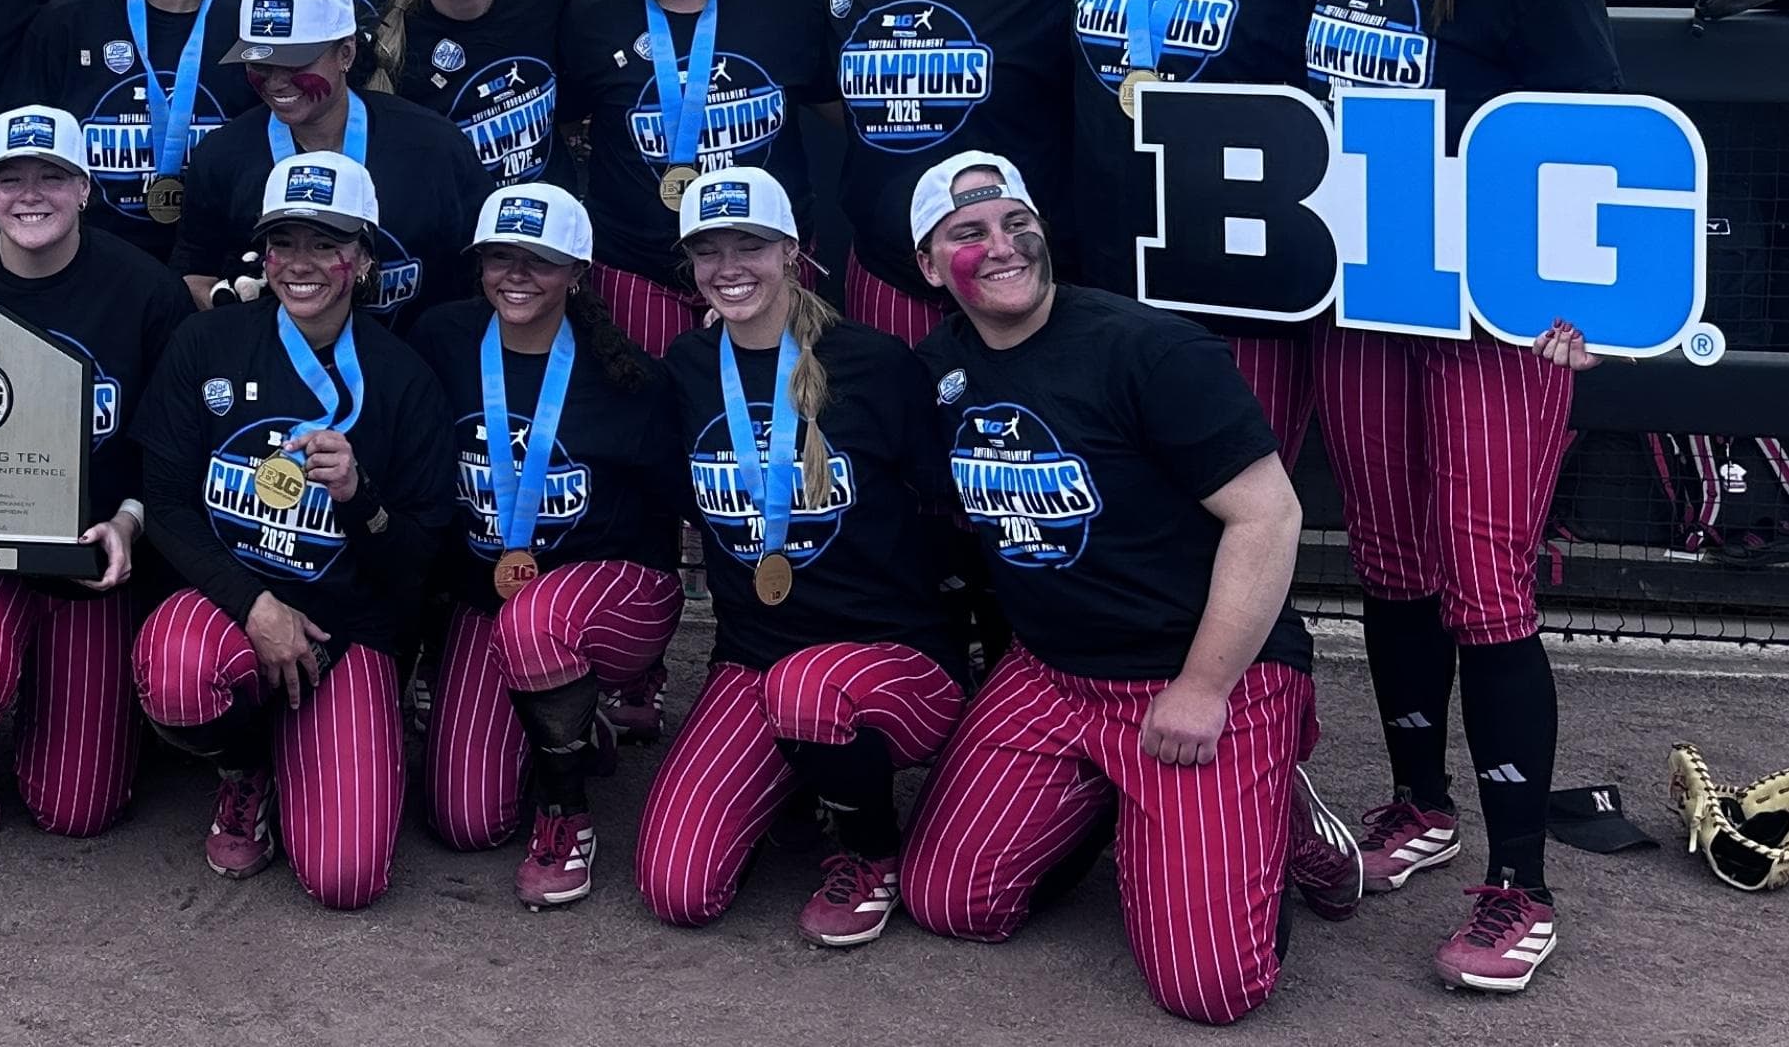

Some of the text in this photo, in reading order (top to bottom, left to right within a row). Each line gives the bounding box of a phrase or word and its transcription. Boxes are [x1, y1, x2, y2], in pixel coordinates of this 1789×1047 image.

[843, 52, 984, 96] CHAMPIONS
[1307, 18, 1424, 85] AMPIONS
[466, 88, 556, 161] AMPION
[635, 92, 783, 153] CHPIONS
[886, 100, 921, 123] 2026
[699, 151, 734, 176] 2026
[1134, 82, 1708, 358] B1G
[17, 452, 50, 463] TEN
[259, 464, 303, 497] B1G
[206, 461, 344, 535] CHAION
[694, 461, 848, 513] CHAMS
[260, 525, 296, 557] 2026
